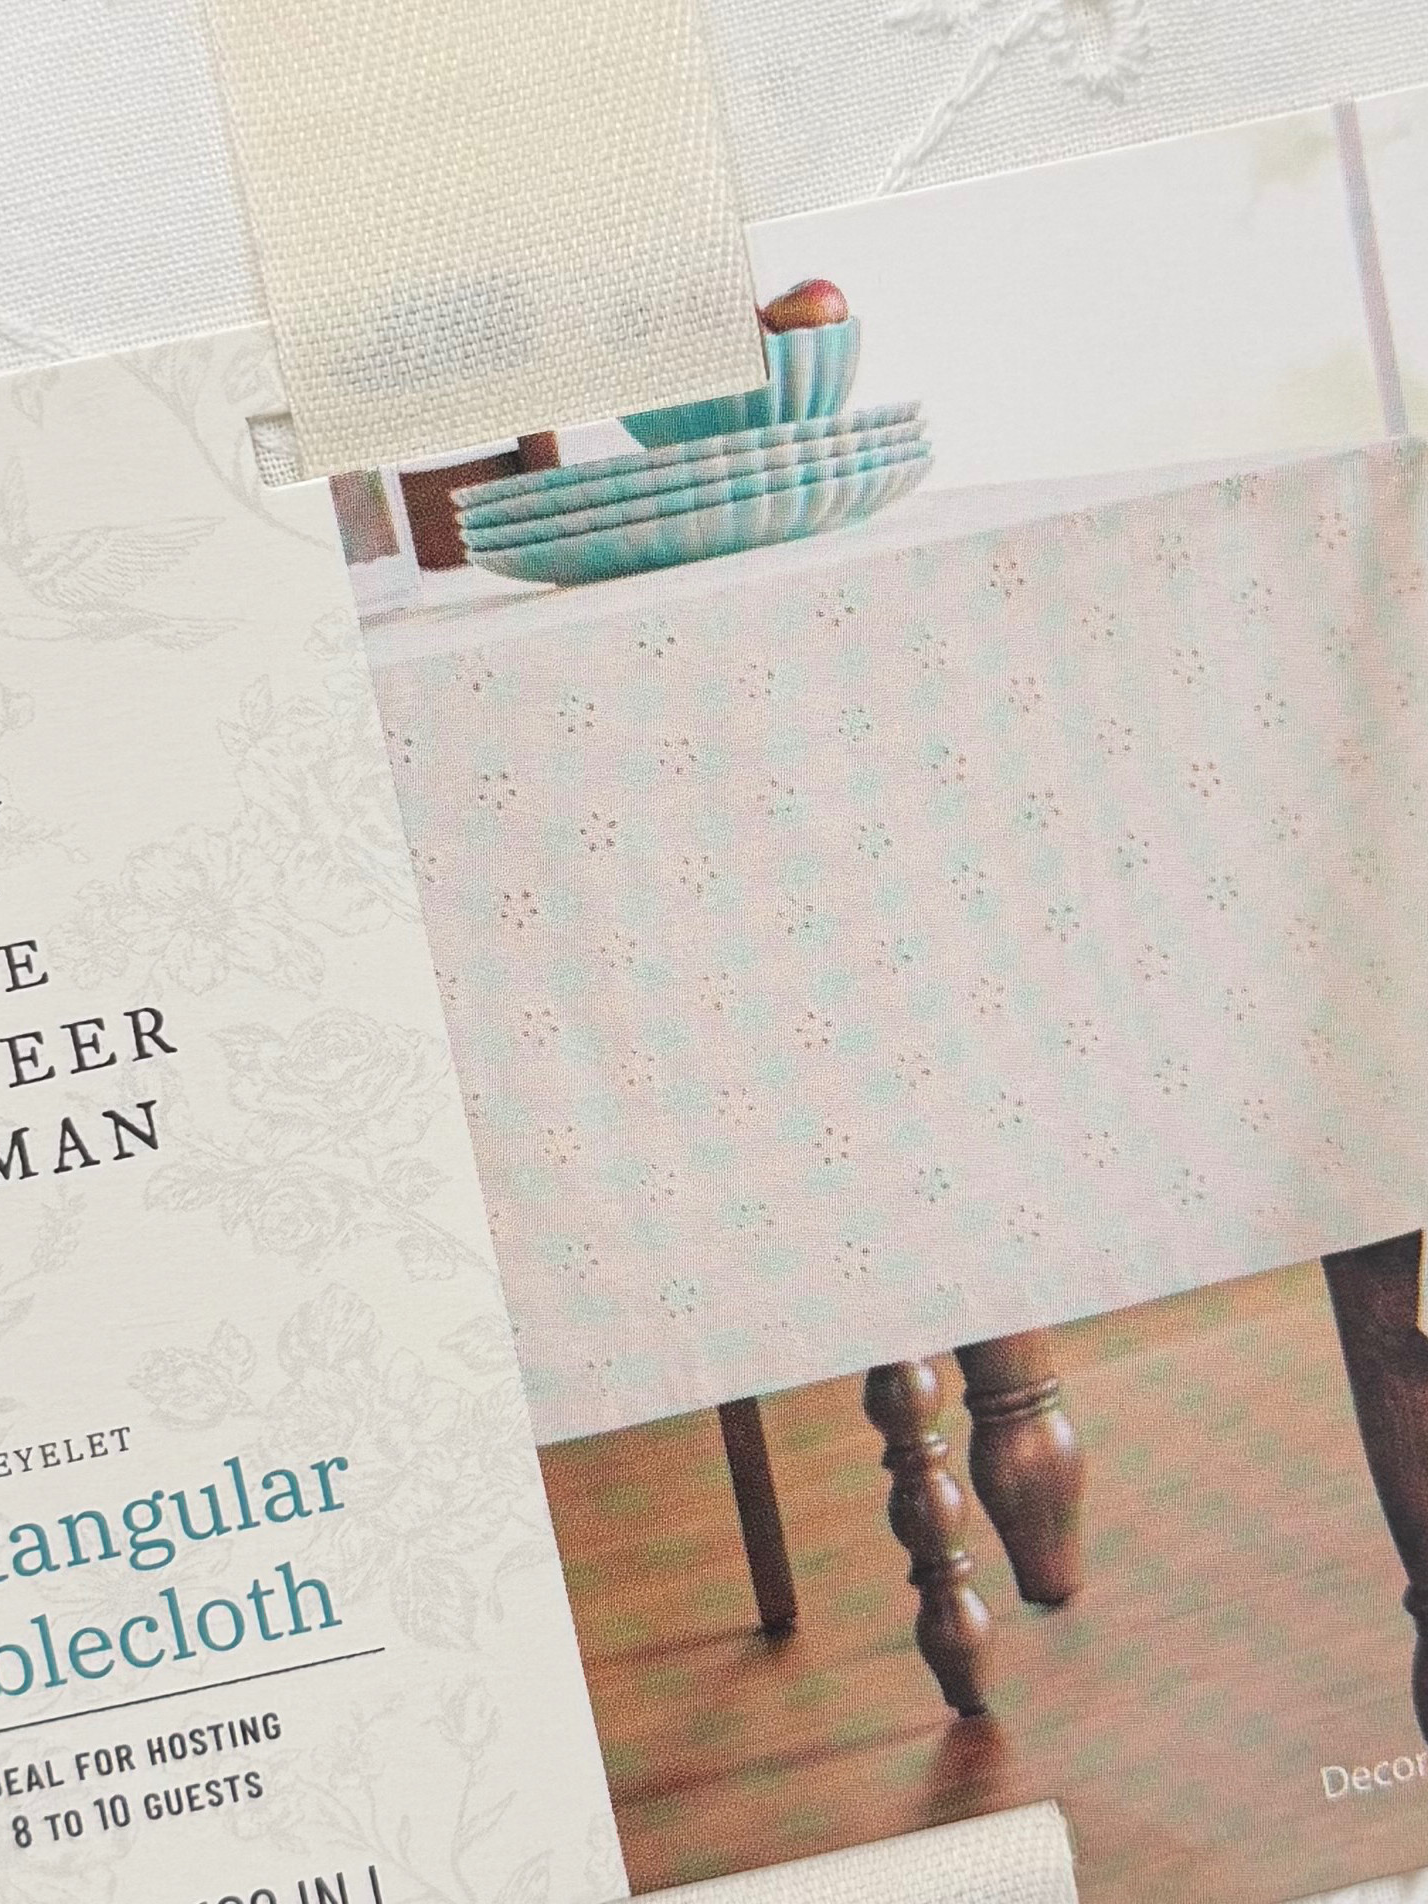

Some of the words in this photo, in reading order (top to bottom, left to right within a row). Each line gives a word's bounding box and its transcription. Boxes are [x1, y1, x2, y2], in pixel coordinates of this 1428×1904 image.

[74, 1743, 137, 1782] FOR
[146, 1711, 282, 1767] HOSTING
[11, 1814, 33, 1849] 8
[42, 1809, 84, 1842] TO
[92, 1793, 132, 1832] 10
[143, 1770, 264, 1821] GUESTS
